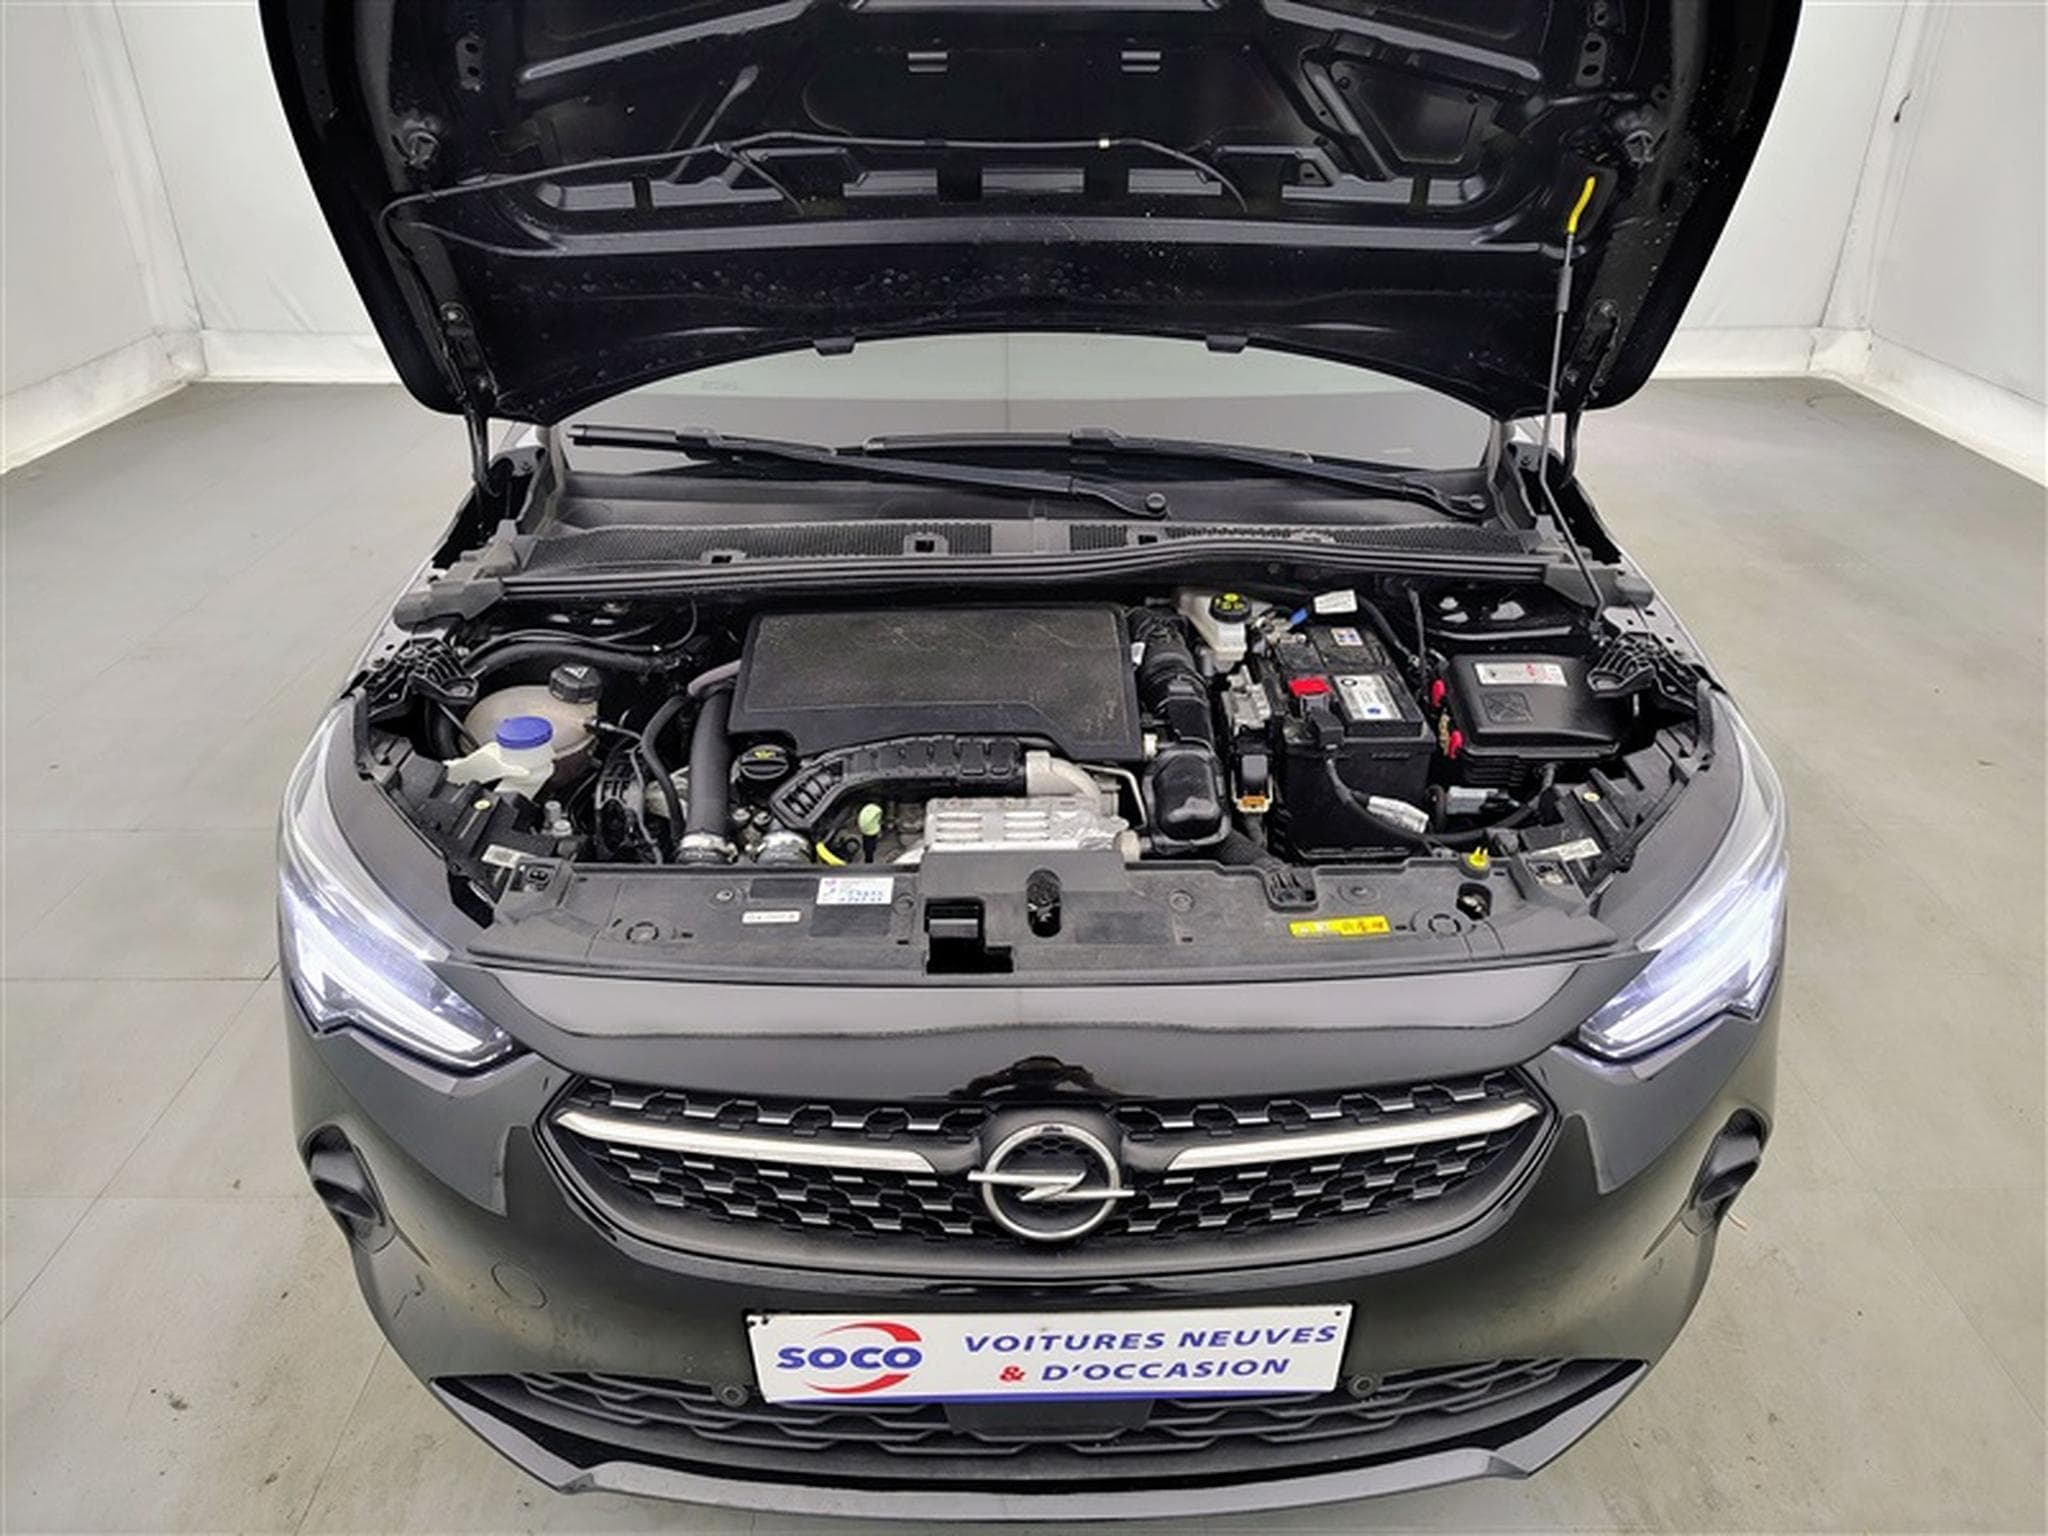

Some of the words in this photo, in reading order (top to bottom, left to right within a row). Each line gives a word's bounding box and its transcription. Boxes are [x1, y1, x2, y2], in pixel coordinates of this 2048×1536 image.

[964, 1333, 1164, 1353] VOITURES
[1179, 1325, 1337, 1348] NEUVES
[776, 1345, 923, 1370] SOCO
[999, 1365, 1025, 1383] &
[1041, 1359, 1290, 1381] D'OCCASION
